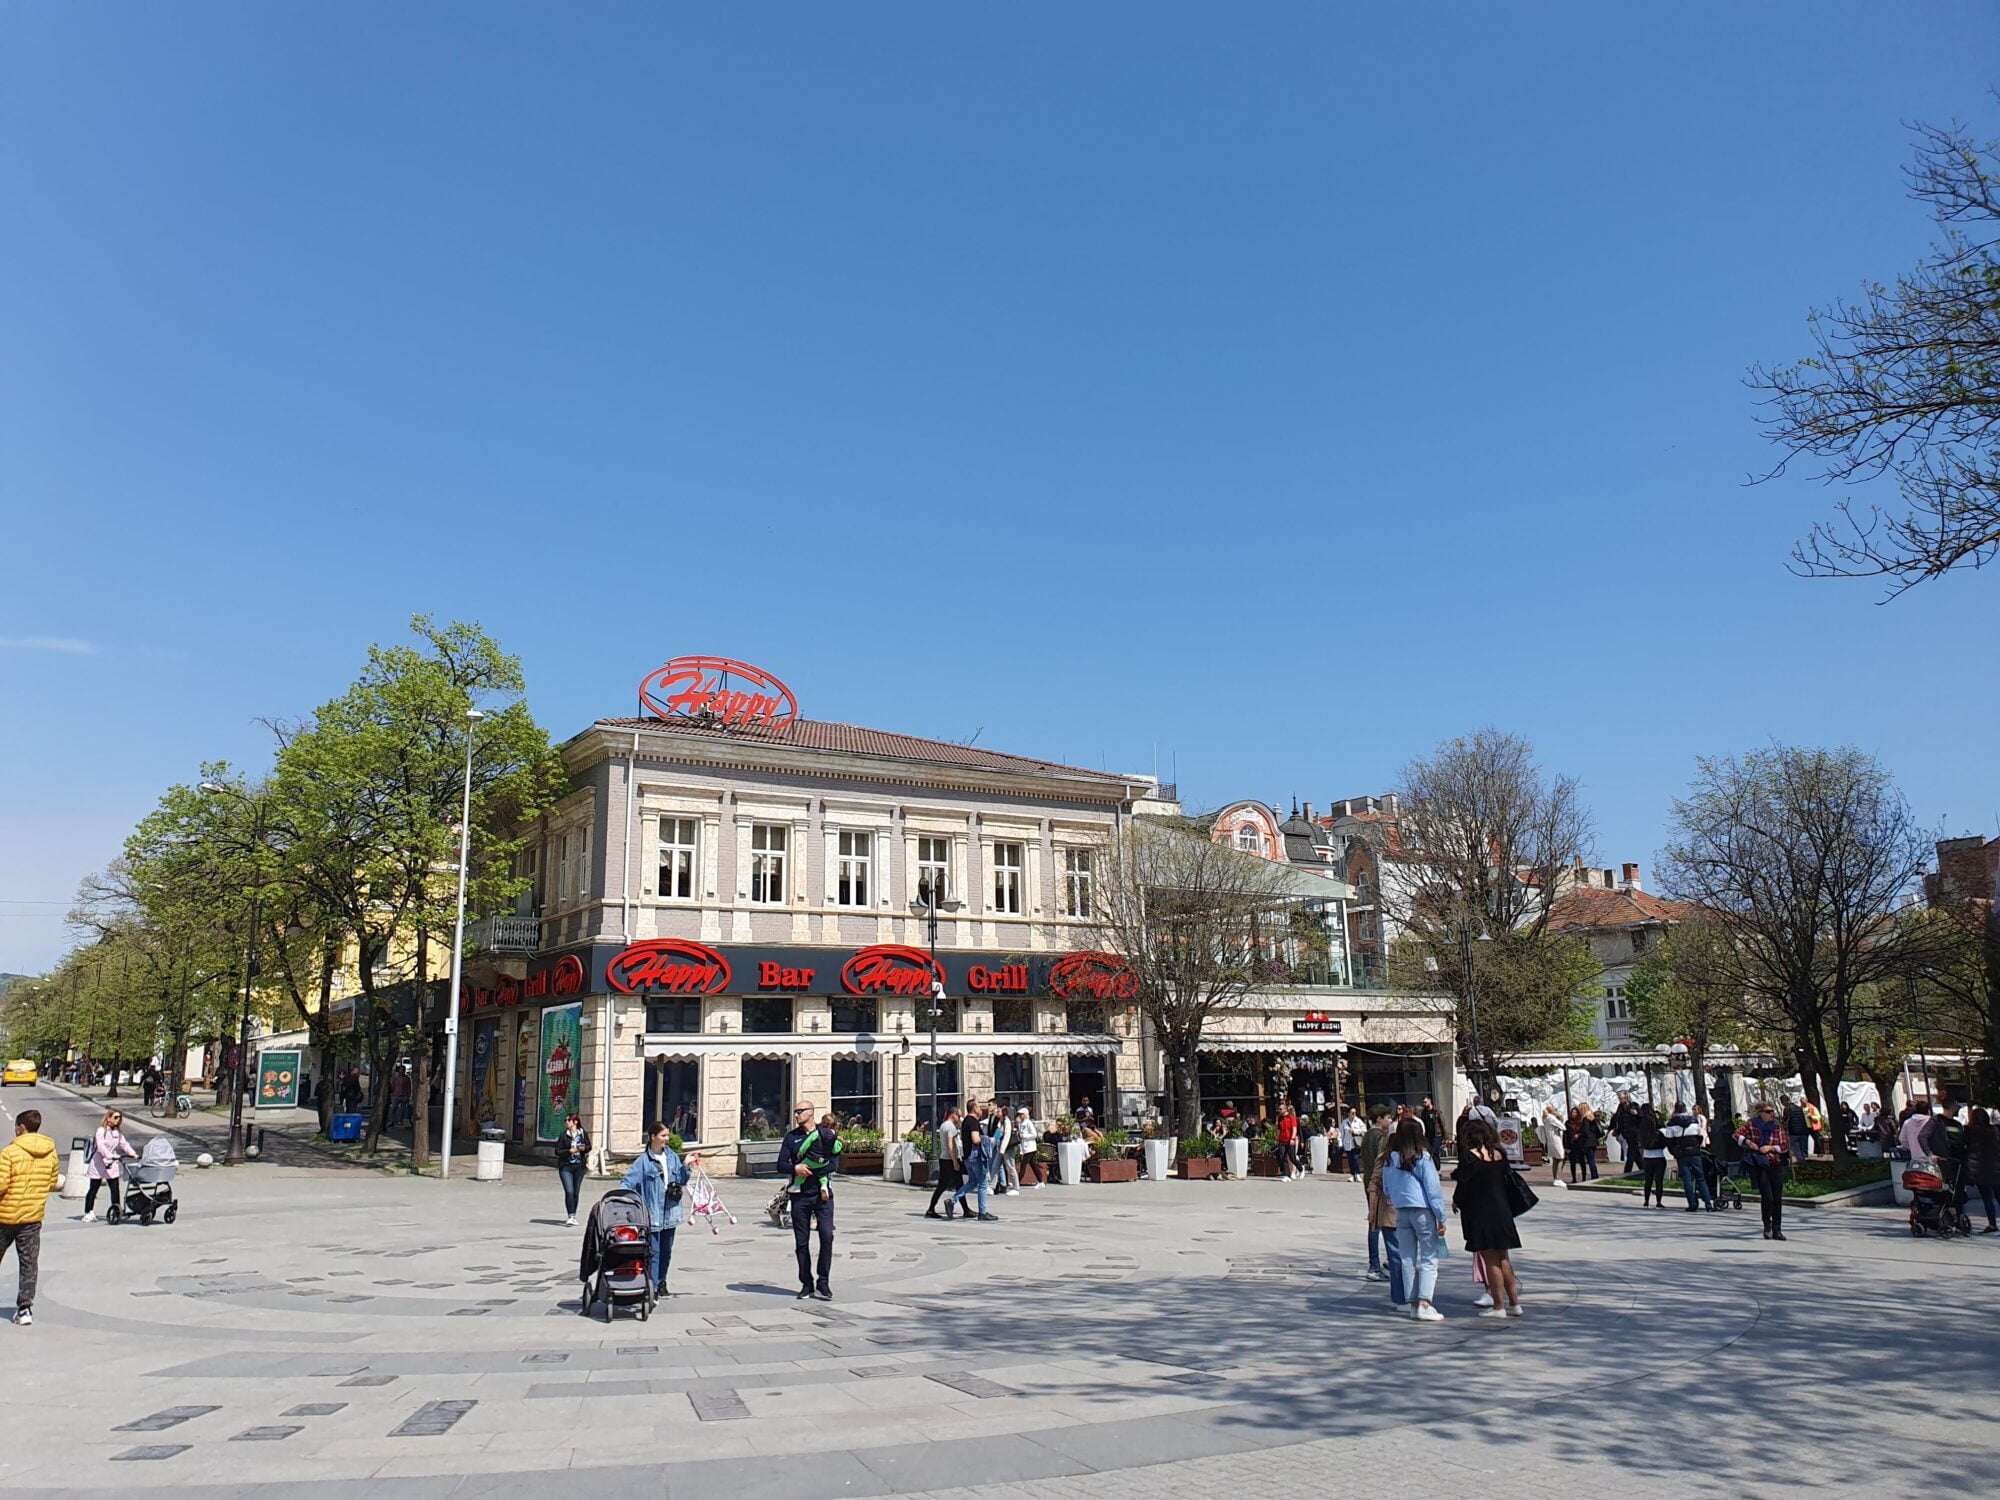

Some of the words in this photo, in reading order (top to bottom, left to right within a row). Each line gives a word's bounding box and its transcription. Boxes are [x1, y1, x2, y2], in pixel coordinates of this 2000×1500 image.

[660, 671, 783, 727] Happy
[623, 951, 720, 993] Happy
[759, 961, 816, 988] Bar
[969, 965, 1028, 989] Grill
[1296, 1022, 1319, 1030] HAPPY
